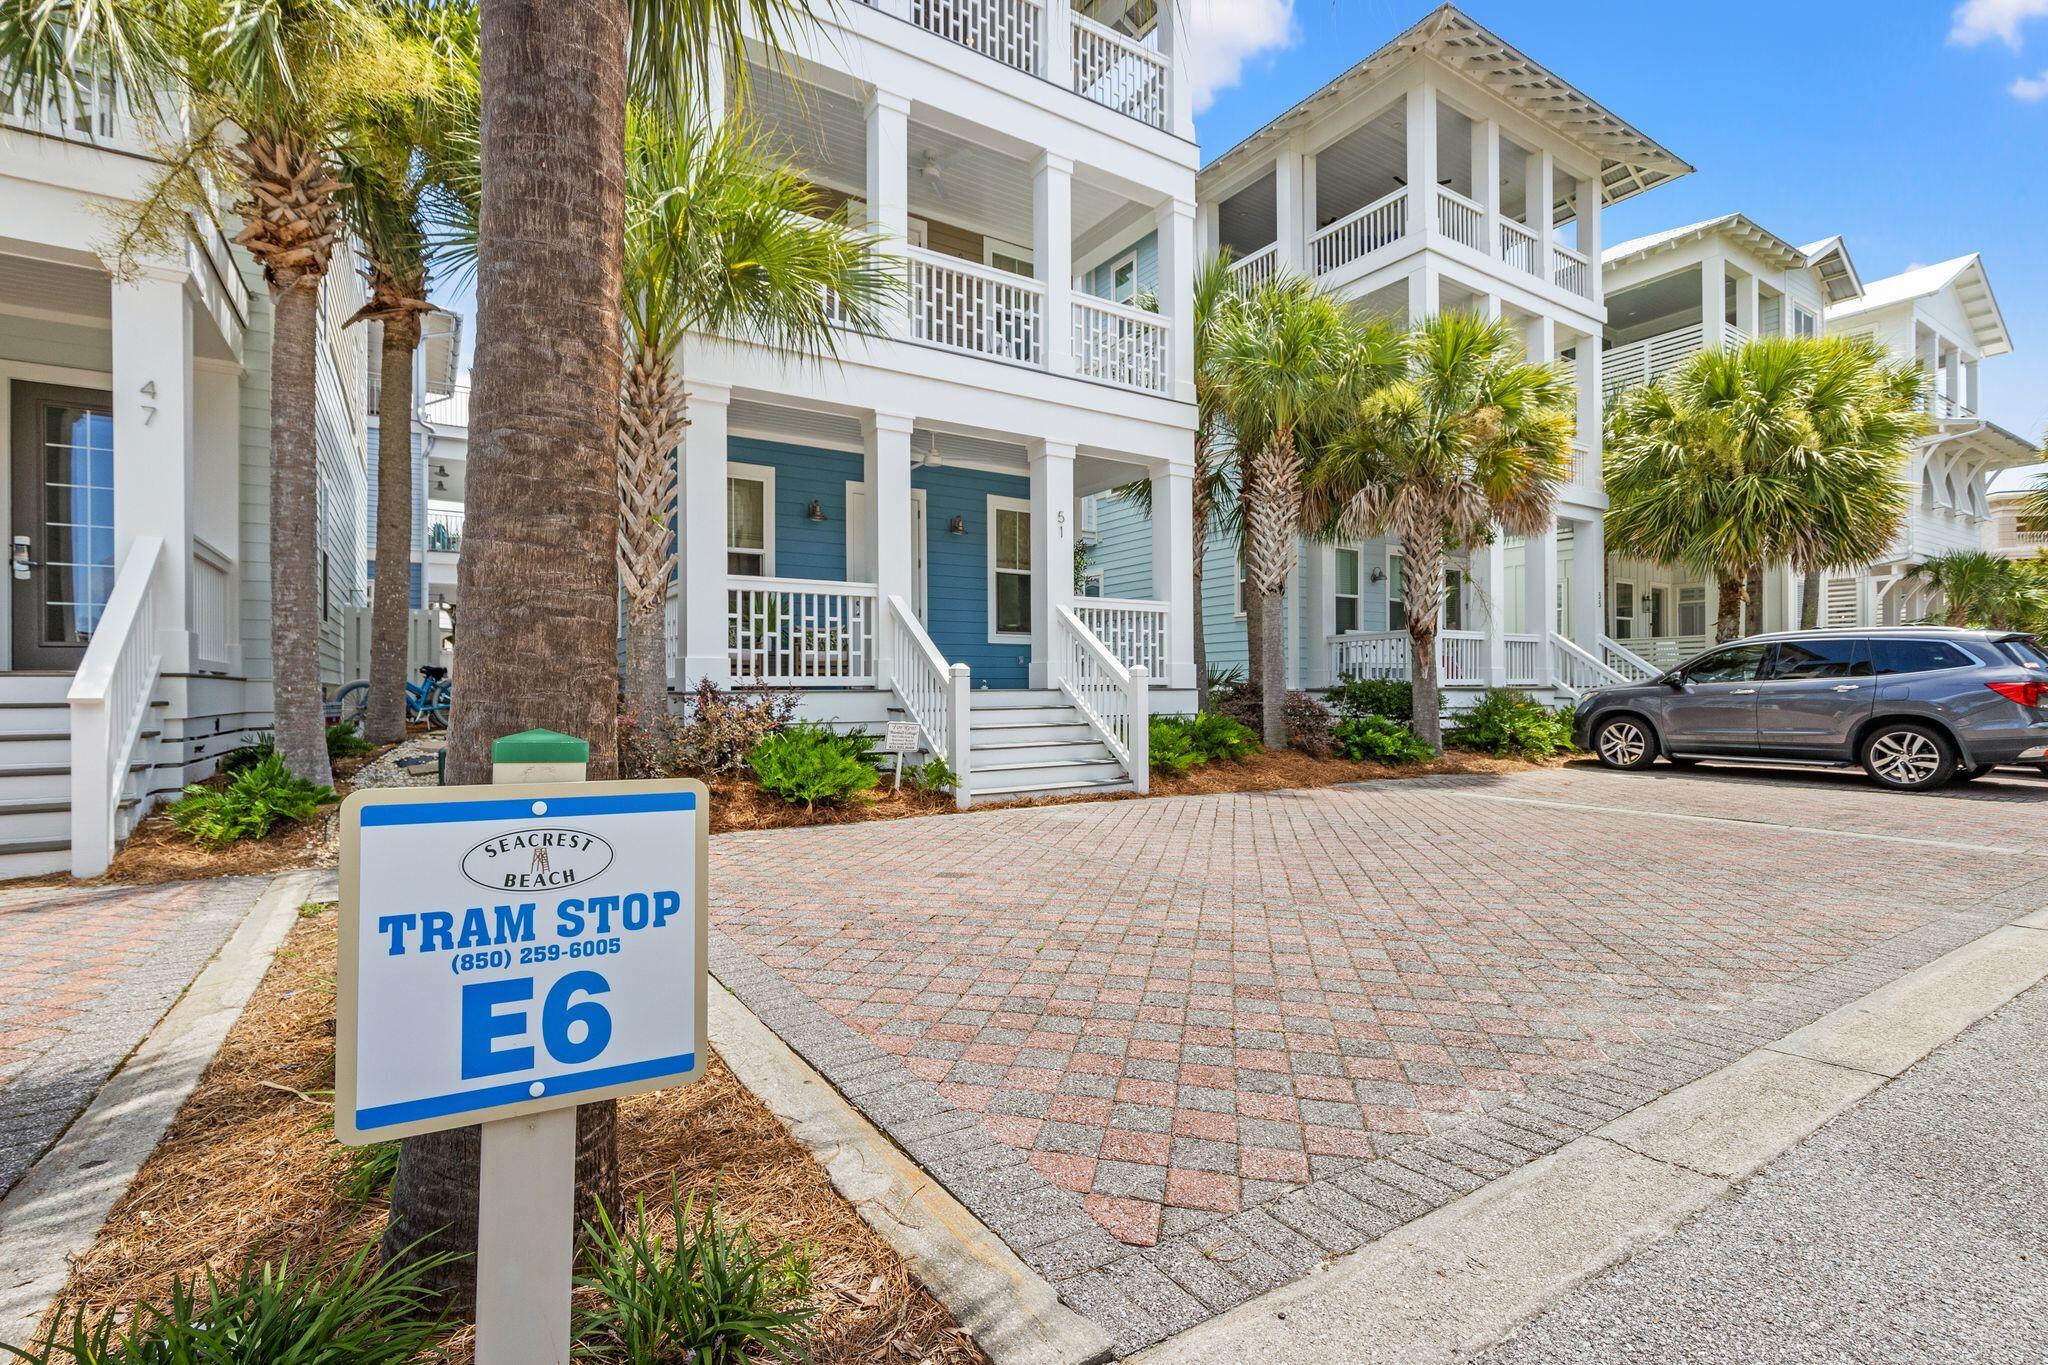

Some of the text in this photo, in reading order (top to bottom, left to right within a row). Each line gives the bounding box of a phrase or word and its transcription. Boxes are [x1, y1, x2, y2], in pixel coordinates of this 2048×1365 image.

[140, 380, 157, 426] 47
[1057, 511, 1065, 539] 51
[484, 832, 594, 859] SEACREST
[503, 868, 576, 888] BEACH
[378, 890, 682, 956] TRAM STOP
[451, 937, 621, 975] (850) 259-6005
[461, 970, 613, 1082] E6
